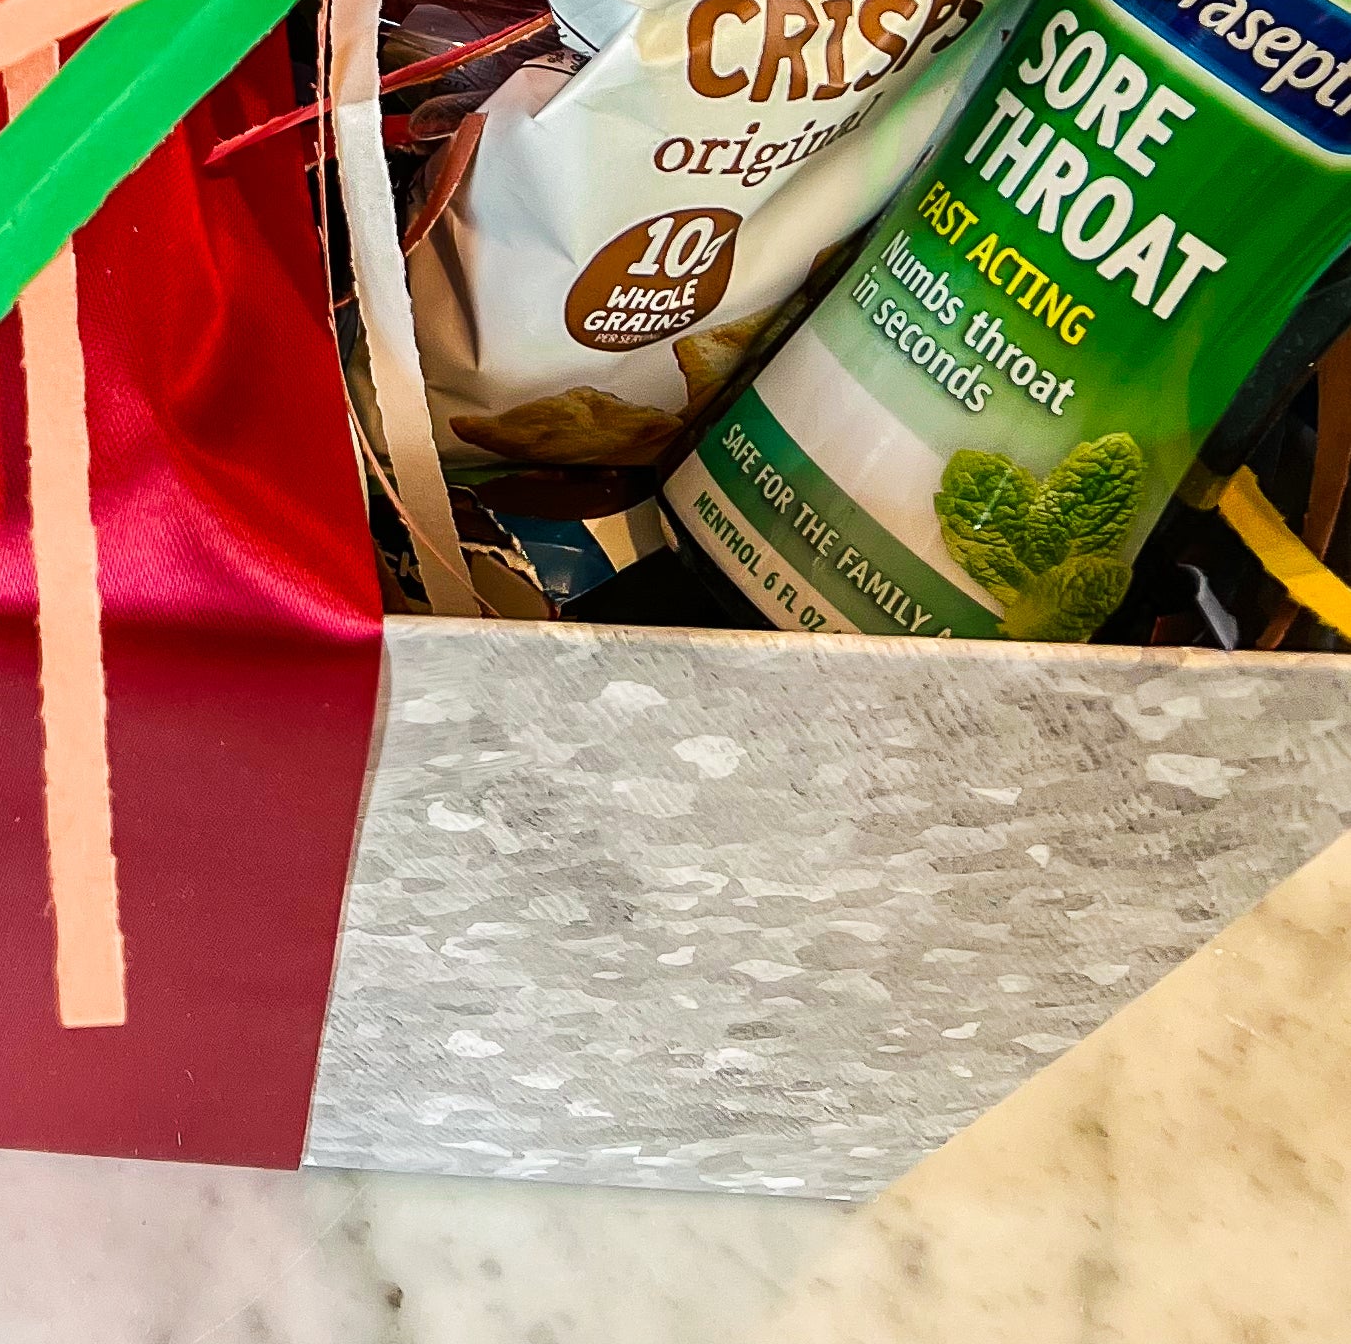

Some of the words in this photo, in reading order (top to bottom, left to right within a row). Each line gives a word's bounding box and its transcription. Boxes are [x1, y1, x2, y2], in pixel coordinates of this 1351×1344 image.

[653, 92, 884, 188] original
[1017, 9, 1197, 177] SORE
[626, 215, 735, 279] 10g
[917, 179, 980, 248] FAST
[965, 232, 1097, 348] ACTING
[963, 86, 1228, 321] THROAT
[583, 308, 695, 334] GRAINS
[605, 276, 699, 312] WHOLE
[851, 264, 878, 307] in
[872, 293, 995, 414] seconds
[880, 228, 967, 326] Numbs
[969, 309, 1079, 417] throat
[692, 489, 764, 579] MENTHOL
[763, 570, 779, 593] 6
[776, 586, 801, 615] FL
[799, 604, 828, 633] OZ
[720, 422, 764, 476] SAFE
[754, 463, 797, 515] FOR
[792, 501, 841, 558] THE
[835, 546, 935, 635] FAMILY
